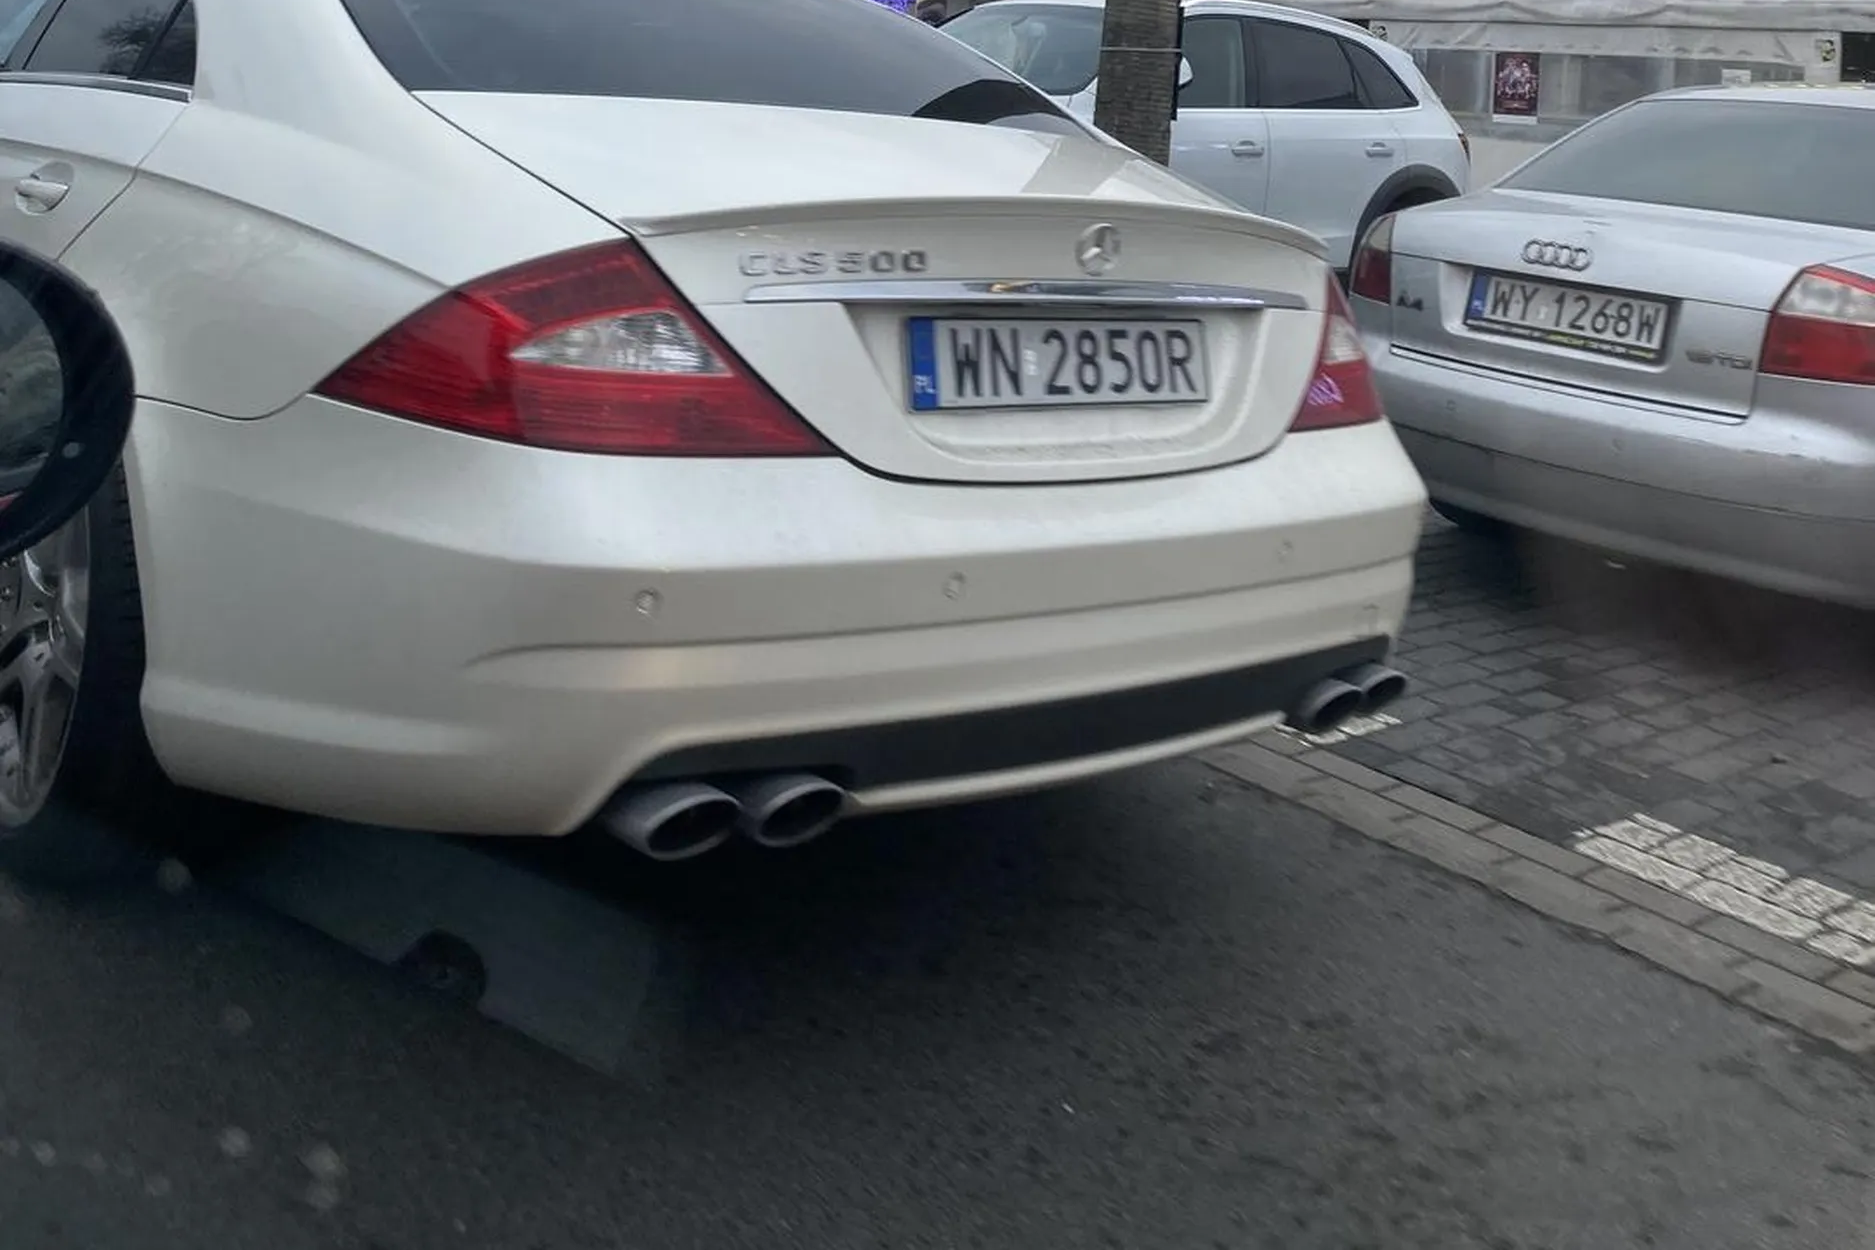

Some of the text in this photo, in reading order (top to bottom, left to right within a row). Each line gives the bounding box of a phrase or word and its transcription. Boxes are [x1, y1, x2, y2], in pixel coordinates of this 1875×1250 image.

[738, 250, 927, 277] CLS 500
[1490, 280, 1541, 321] WY
[1552, 291, 1662, 345] 1268W
[948, 327, 1197, 398] WN 2850R
